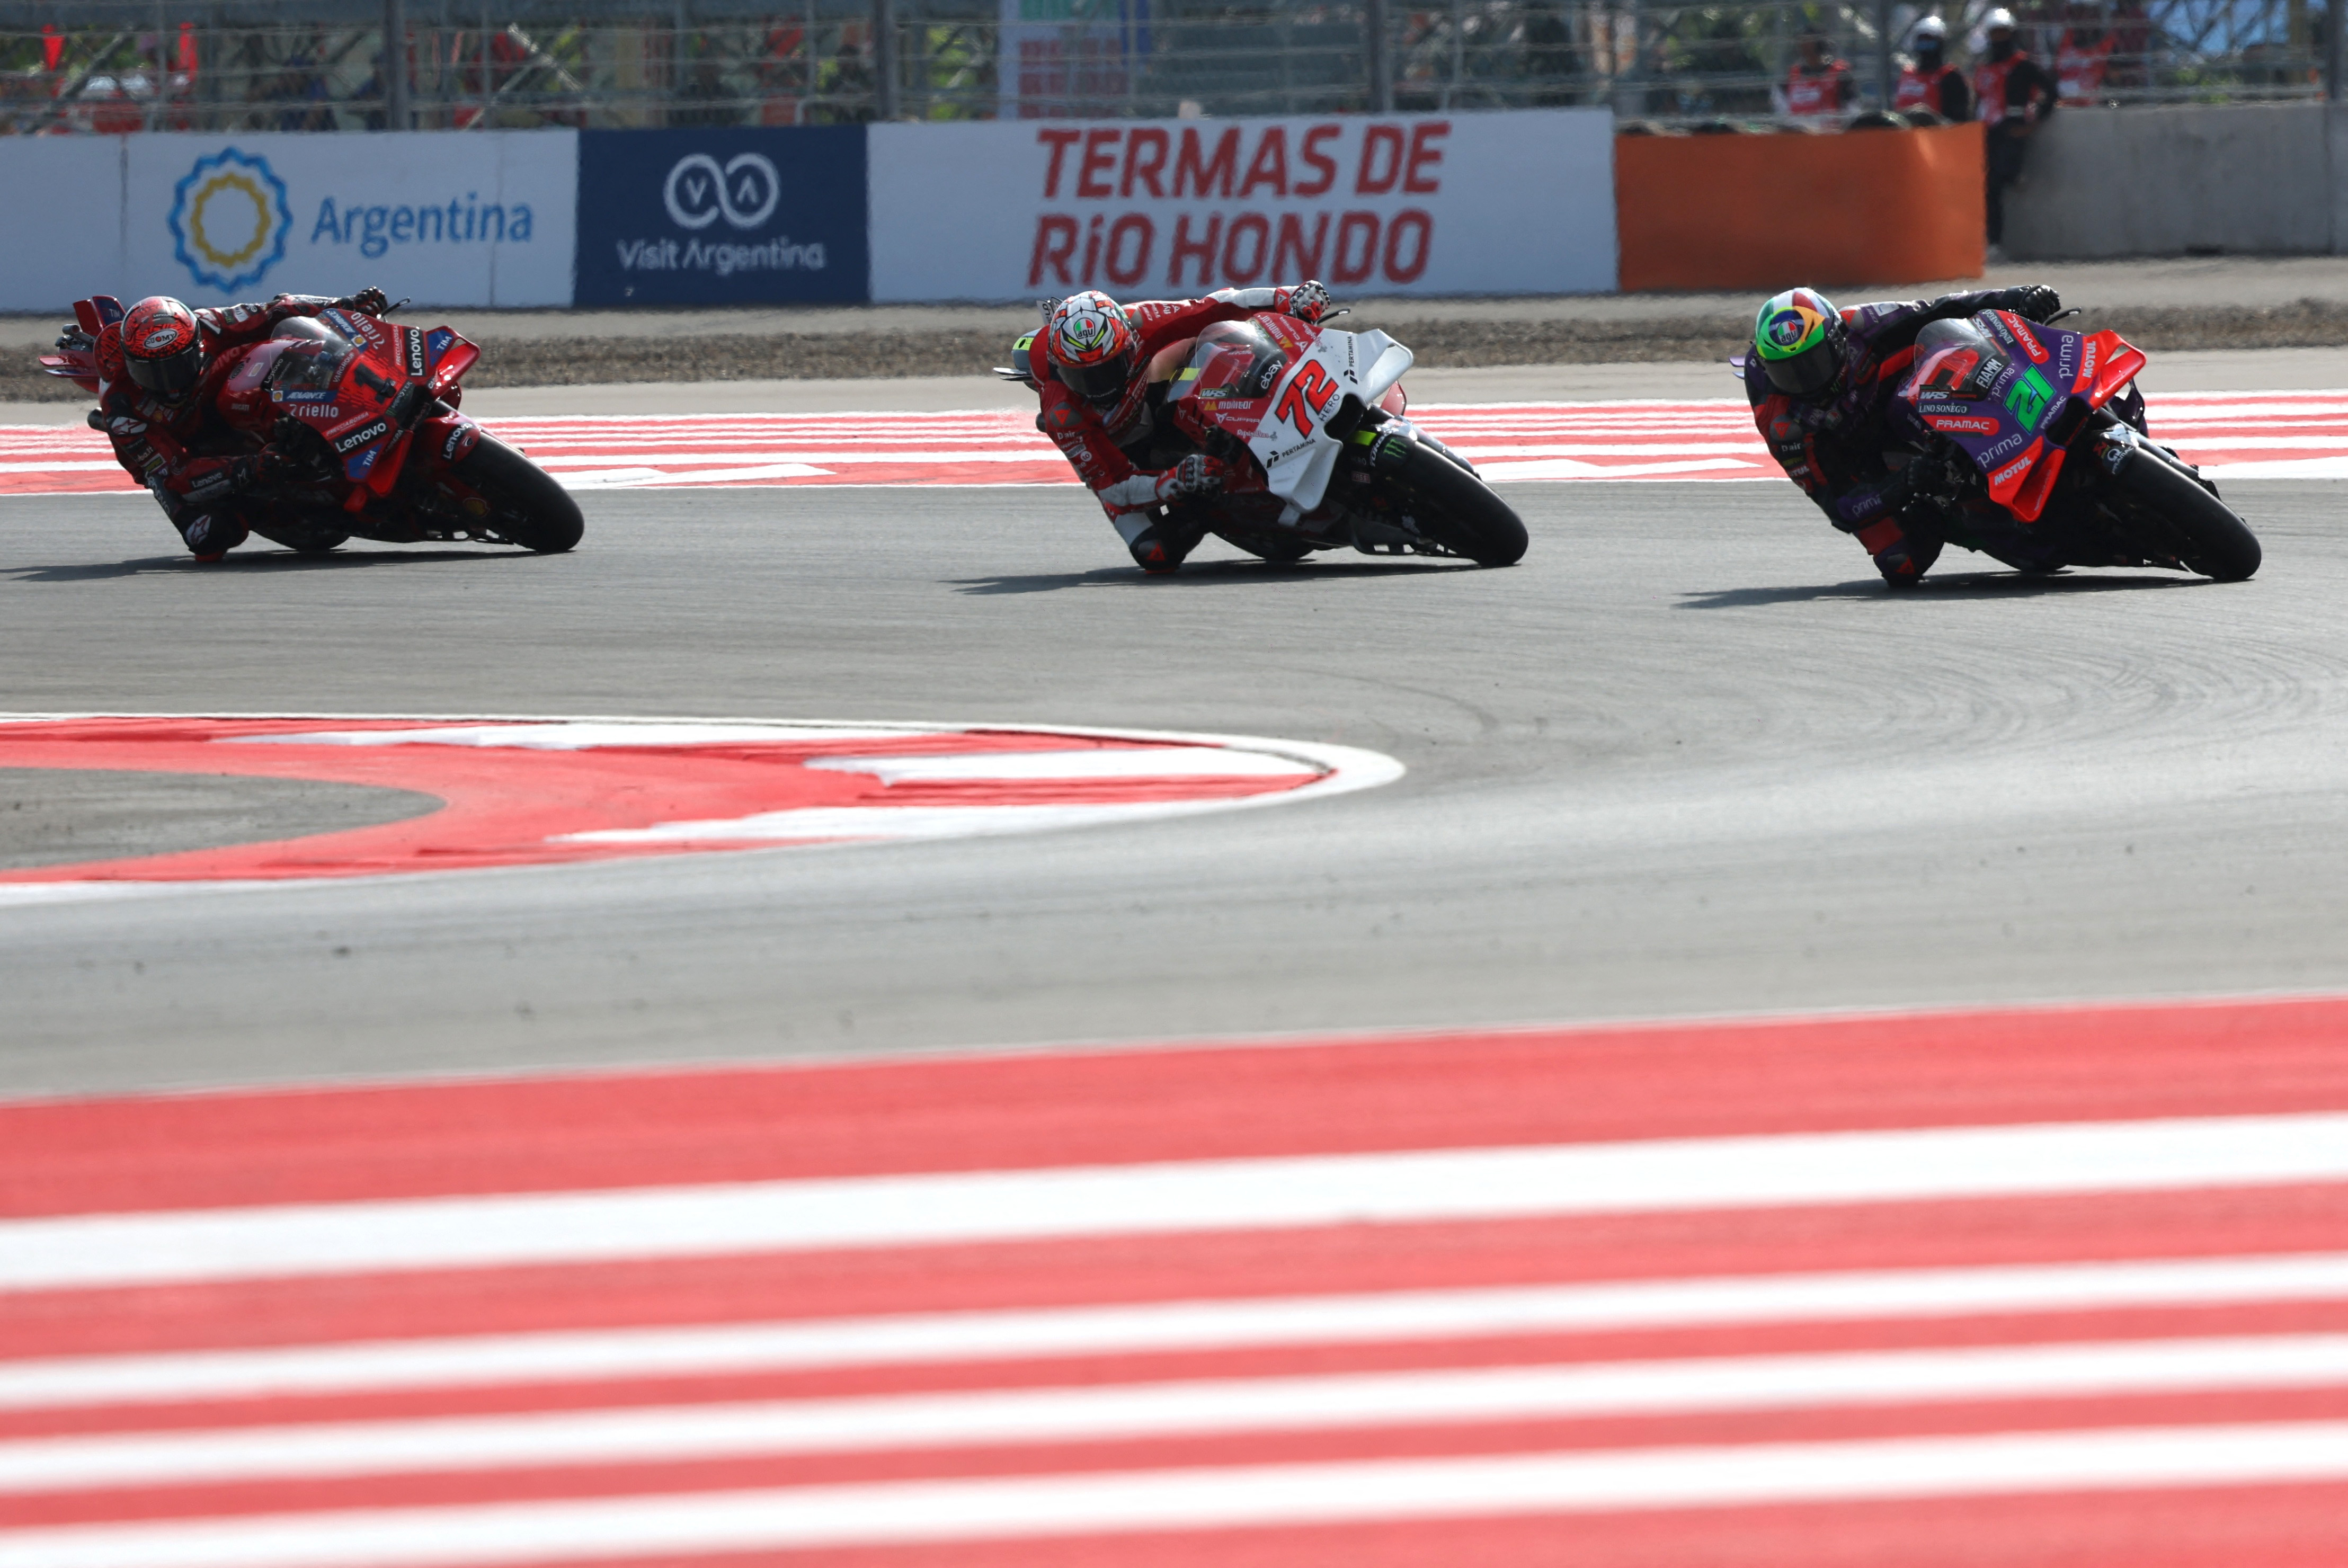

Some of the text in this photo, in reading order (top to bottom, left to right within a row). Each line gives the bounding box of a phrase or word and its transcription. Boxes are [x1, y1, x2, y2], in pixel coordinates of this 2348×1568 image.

[1037, 120, 1452, 198] TERMAS DE
[311, 192, 534, 259] Argentina
[617, 235, 826, 277] Visit Argentina
[1169, 207, 1433, 288] HONDO
[109, 308, 121, 319] TIM
[436, 335, 452, 350] TIM
[1078, 328, 1093, 337] agv
[1781, 331, 1798, 343] agv
[2007, 315, 2042, 357] PRAMAC
[410, 328, 423, 377] Lenovo
[2058, 335, 2074, 379] prima
[2083, 341, 2096, 378] MOTUL
[1260, 360, 1284, 390] ebay
[1976, 358, 2002, 388] FIAMM
[1991, 366, 2015, 398] prima
[1275, 359, 1339, 440] 72
[1319, 394, 1340, 422] HERO
[2003, 363, 2057, 436] 21
[2040, 395, 2067, 430] PRAMAC
[334, 422, 387, 453] Lenovo
[1936, 420, 1990, 430] PRAMAC
[442, 422, 473, 460] Lenovo
[1282, 438, 1317, 458] PERTAMINA
[1977, 433, 2023, 469] prima
[362, 449, 377, 467] TIM
[1994, 456, 2032, 486] MOTUL
[192, 471, 223, 489] Lenovo
[1851, 494, 1881, 518] prima
